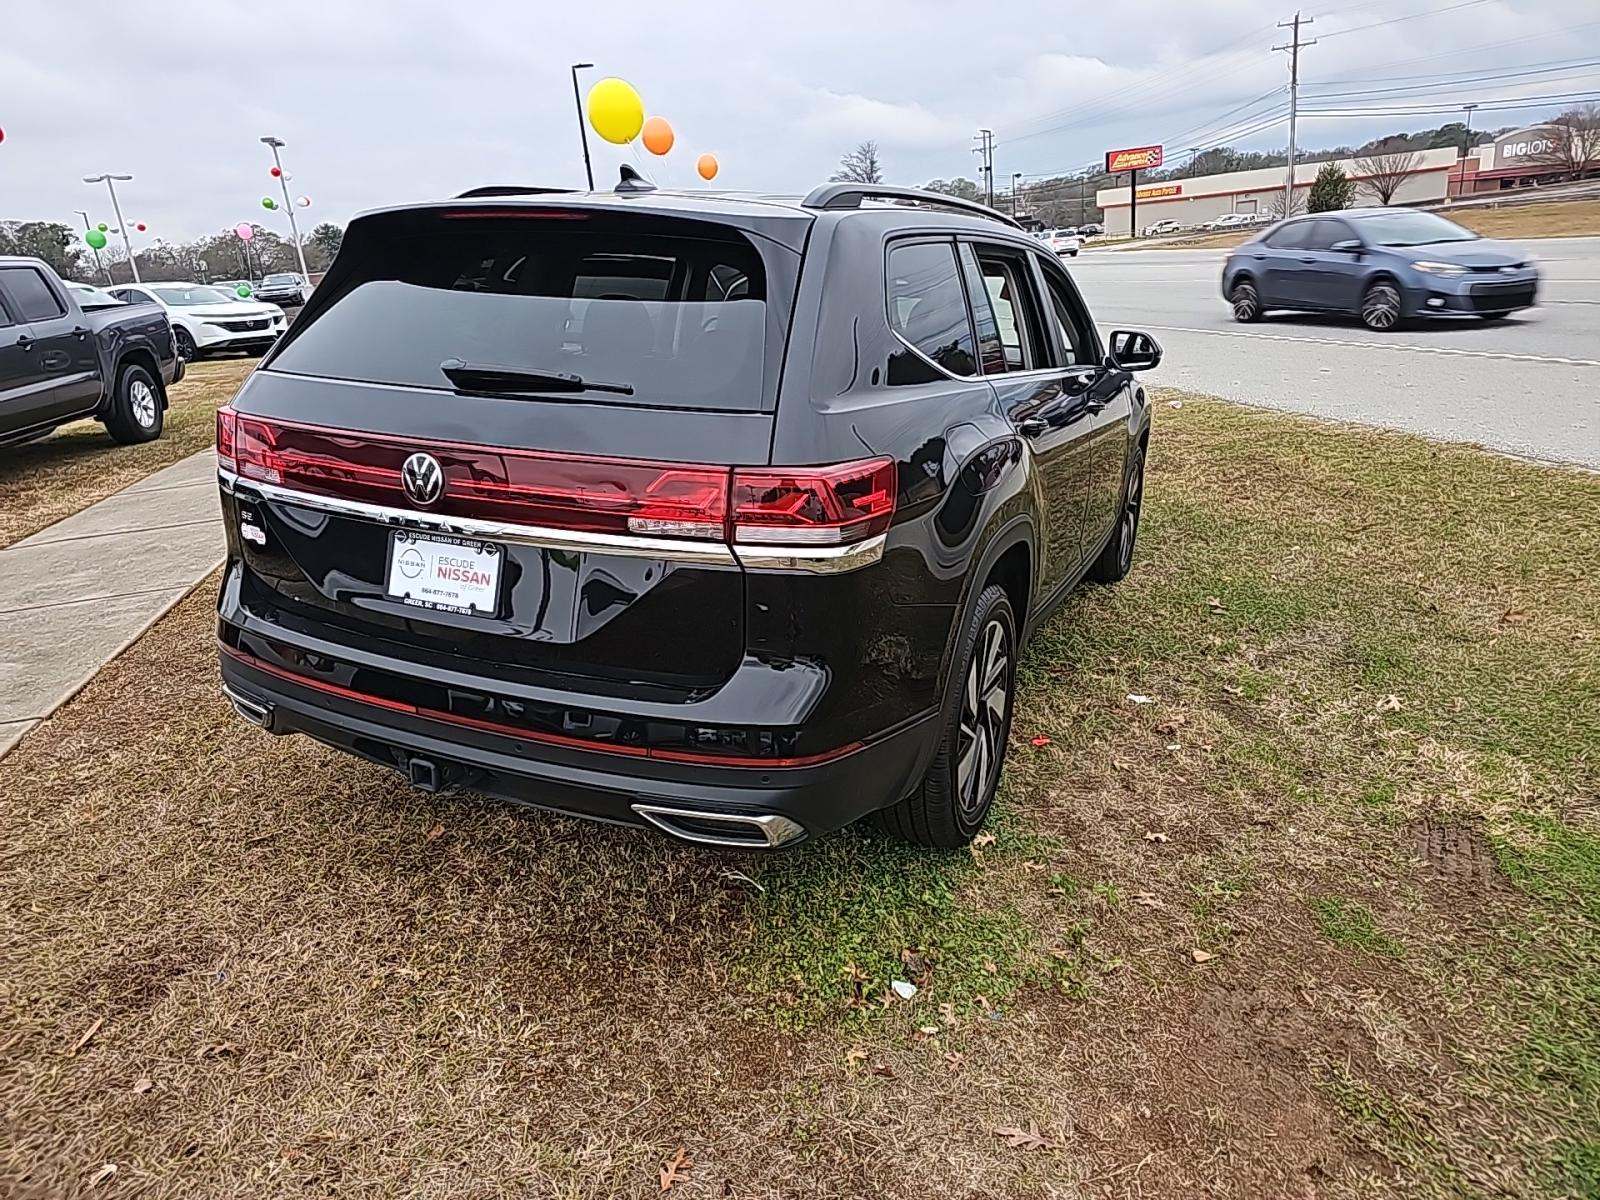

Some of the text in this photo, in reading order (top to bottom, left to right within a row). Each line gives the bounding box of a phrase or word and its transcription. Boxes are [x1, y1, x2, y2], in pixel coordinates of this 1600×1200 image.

[408, 532, 431, 542] ESCUDE
[431, 535, 452, 544] NISSAN
[398, 559, 426, 569] NISSAN
[438, 556, 475, 570] ESCUDE
[437, 567, 492, 587] NISSAN
[424, 601, 433, 609] SC
